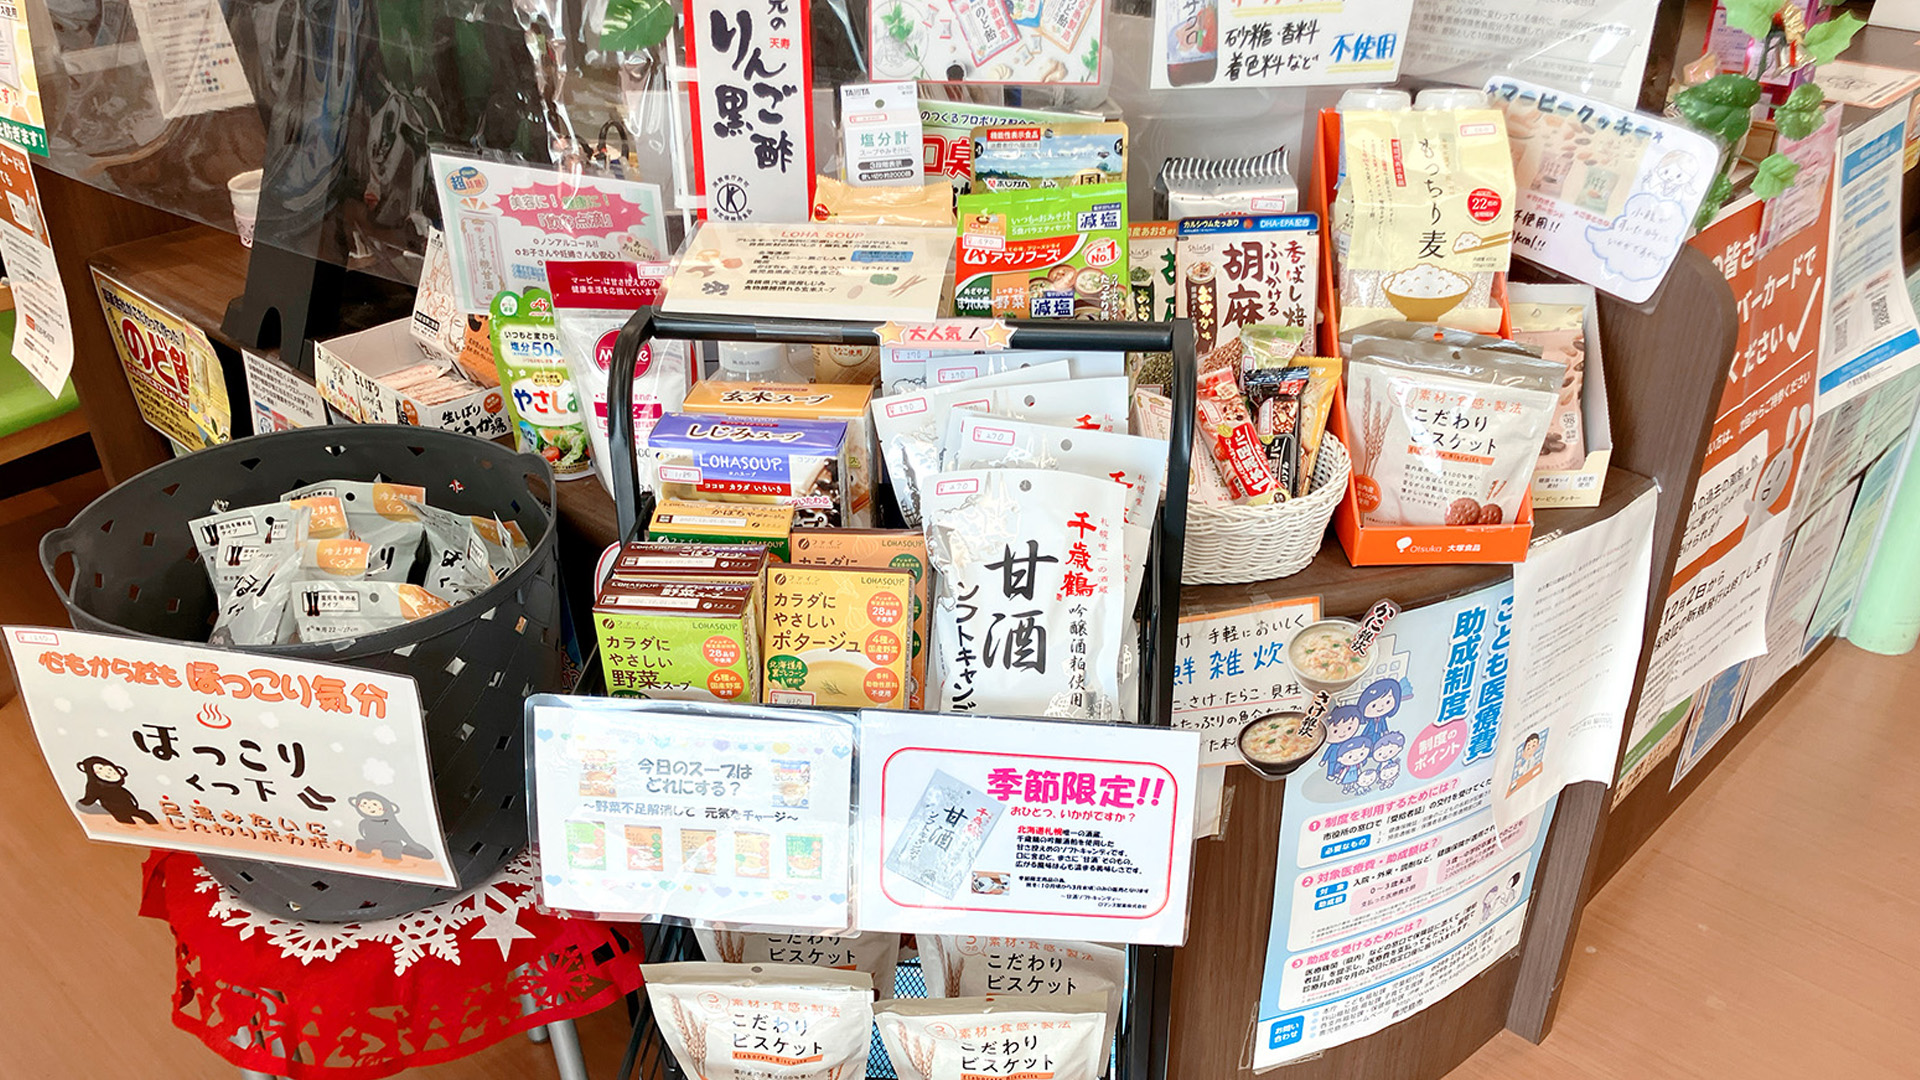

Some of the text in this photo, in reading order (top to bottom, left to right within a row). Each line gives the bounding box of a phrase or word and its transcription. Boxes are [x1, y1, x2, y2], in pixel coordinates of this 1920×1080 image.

[769, 37, 791, 49] 天寿
[1224, 19, 1321, 50] 砂糖・香料
[1330, 33, 1398, 63] 不使用
[1225, 53, 1320, 81] 着色料など
[1499, 82, 1653, 137] マービークッキー
[860, 131, 908, 147] 塩分計
[990, 130, 1039, 140] 機能性表示食品
[1417, 138, 1448, 259] もっちり麦
[1012, 223, 1071, 236] 5食バラエティセット
[1080, 212, 1118, 229] 減塩
[1183, 218, 1240, 229] カルシウムたっぷり
[991, 250, 1061, 265] アマノフーズ
[1222, 240, 1265, 328] 胡麻
[1264, 241, 1283, 316] ふりかける
[995, 294, 1026, 309] 野菜
[1033, 299, 1072, 316] 減塩
[1728, 322, 1785, 384] ください
[722, 390, 833, 405] 玄米スープ
[442, 403, 481, 425] 生しぼり
[1413, 407, 1489, 432] こだわり
[687, 423, 805, 442] しじみスープ
[1410, 429, 1497, 456] ビスケット
[699, 453, 783, 472] LOHASOUP
[728, 484, 751, 492] カラダ
[753, 485, 783, 493] いきいき
[323, 546, 363, 557] 冷え対策
[882, 540, 925, 548] LOHASOUP
[1060, 511, 1098, 597] 千歳鶴
[1410, 543, 1481, 553] Otsuka 大塚食品
[329, 556, 356, 568] くつ下
[861, 577, 905, 586] LOHASOUP
[660, 589, 723, 598] 野菜スープ
[774, 592, 836, 609] カラダに
[982, 539, 1060, 675] 甘酒
[692, 622, 738, 631] LOHASOUP
[773, 613, 836, 629] やさしい
[1207, 612, 1306, 645] 手軽においしく
[1349, 601, 1396, 657] かに雑炊
[606, 636, 671, 651] カラダに
[772, 630, 861, 653] ポタージュ
[868, 645, 898, 653] 国産野菜
[872, 635, 895, 645] 4種の
[609, 654, 673, 668] やさしい
[1068, 603, 1089, 707] 吟醸酒粕使用
[1437, 605, 1488, 724] 助成制度
[38, 650, 389, 721] 心もからだも ほっこり気分
[612, 669, 692, 691] 野菜スープ
[710, 682, 741, 690] 国産野菜
[713, 673, 737, 682] 6種の
[1464, 594, 1514, 763] こども医療費
[1297, 691, 1331, 739] さけ雑炊
[131, 723, 307, 780] ほっこり
[1418, 729, 1458, 755] 制度の
[1414, 742, 1461, 772] ポイント
[637, 757, 753, 780] 今日のスープは
[185, 773, 278, 803] くつ下
[645, 777, 741, 798] どれにする？
[1010, 805, 1136, 822] おひとつ、いかがですか？
[1324, 778, 1458, 828] 制度を利用するためには？
[166, 816, 354, 854] じんわりポカポカ
[1016, 834, 1115, 848] 千歳鶴の吟醸酒粕を使用した
[1316, 838, 1439, 885] 対象医療費・助成額は？
[988, 934, 1097, 962] 素材・食感・製法
[1306, 918, 1423, 967] 助成を受けるためには？
[769, 947, 857, 965] ビスケット
[987, 952, 1064, 973] こだわり
[987, 974, 1078, 996] ビスケット
[731, 997, 841, 1019] 素材・食感・製法
[1390, 998, 1425, 1020] 鹿児島市
[733, 1013, 808, 1036] こだわり
[958, 1020, 1072, 1039] 素材・食感・製法
[1274, 1022, 1300, 1034] お問い
[733, 1033, 823, 1056] ビスケット
[961, 1035, 1038, 1056] こだわり
[1273, 1030, 1299, 1044] 合わせ
[734, 1053, 773, 1062] Elaborate
[961, 1054, 1054, 1074] ビスケット
